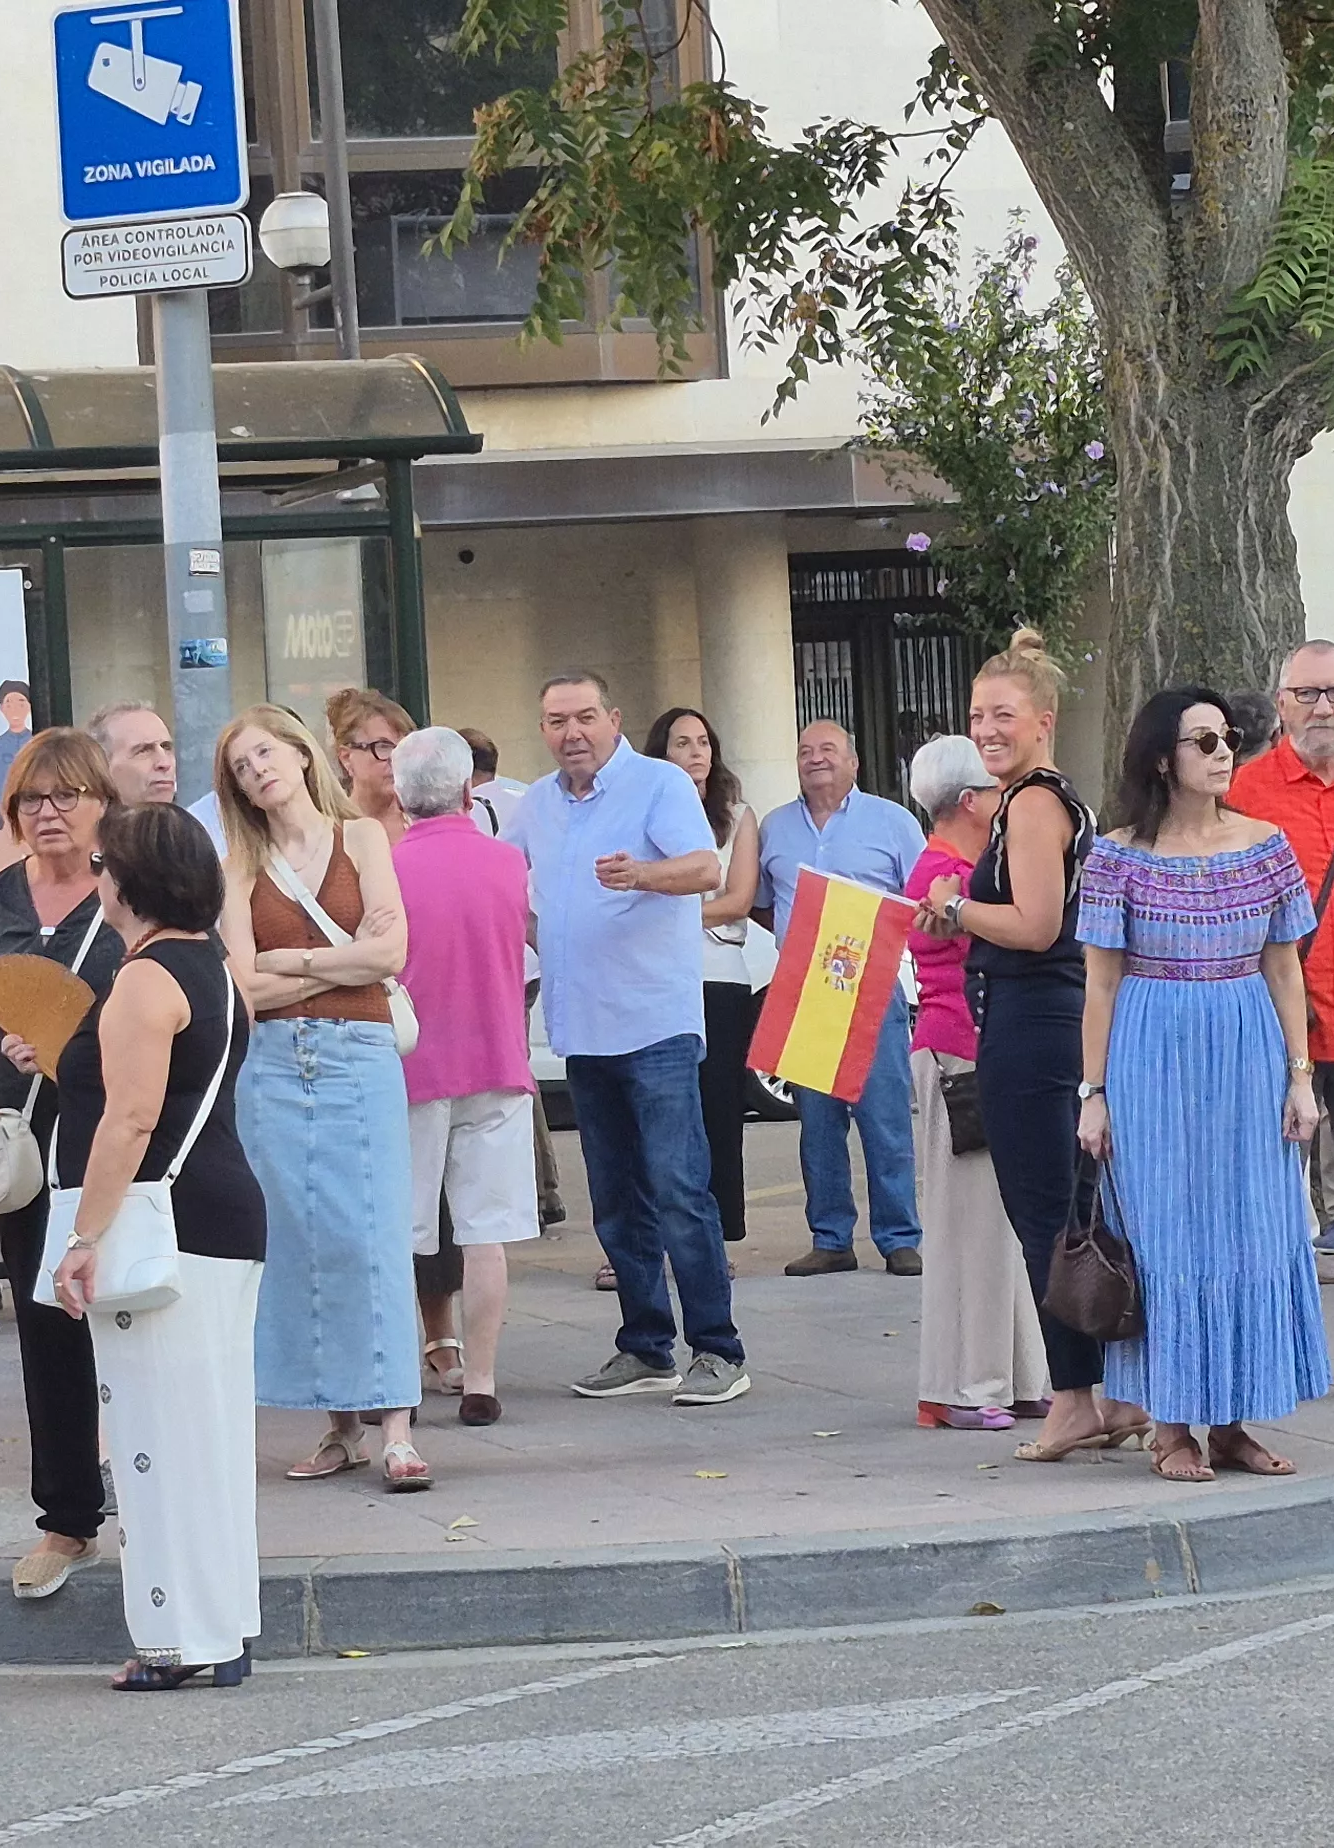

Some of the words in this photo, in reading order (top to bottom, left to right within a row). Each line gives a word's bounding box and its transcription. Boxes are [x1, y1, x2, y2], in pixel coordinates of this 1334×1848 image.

[83, 162, 133, 183] ZONA
[135, 153, 216, 178] VIGILADA
[81, 233, 119, 249] ÁREA
[124, 223, 225, 244] CONTROLADA
[74, 252, 103, 266] POR
[108, 239, 235, 263] VIDEOVIGILANCIA
[99, 270, 157, 288] POLICÍA
[162, 266, 210, 282] LOCAL
